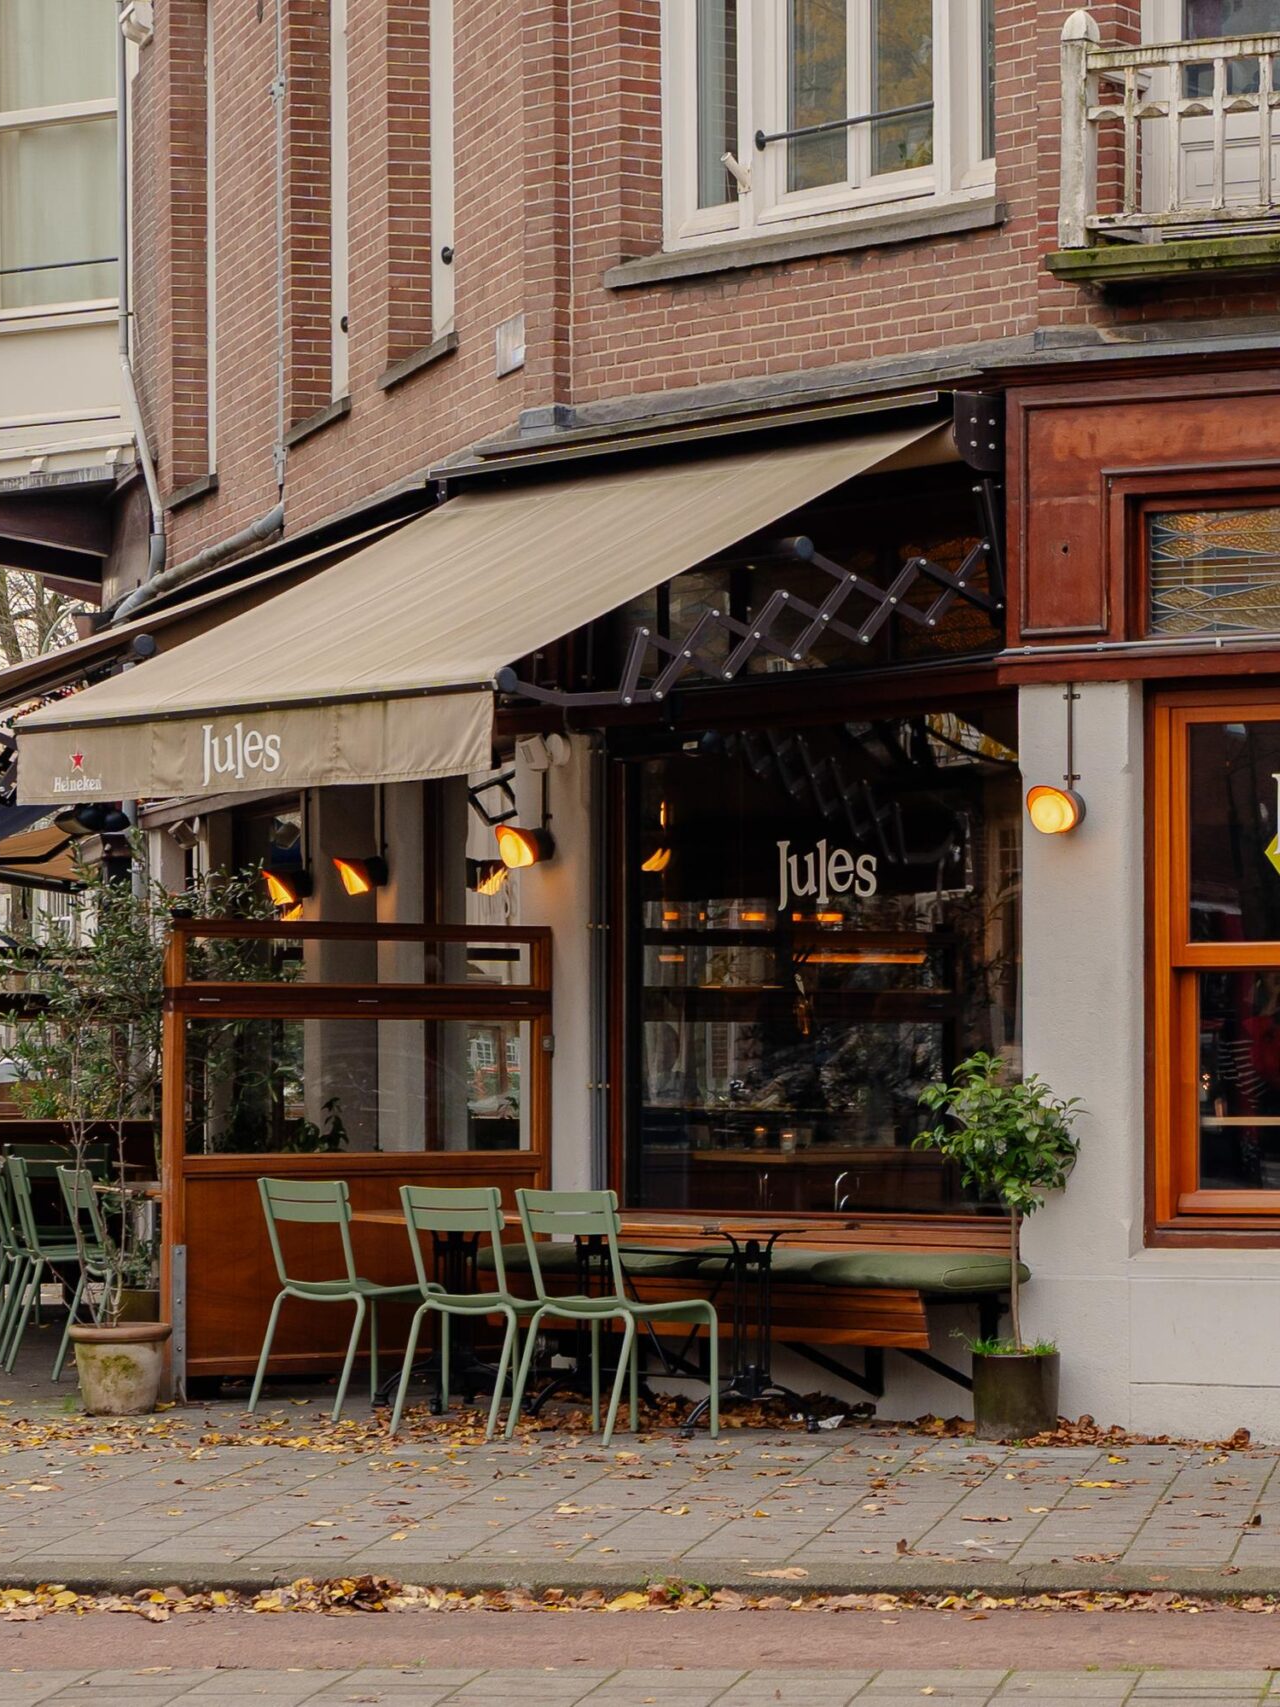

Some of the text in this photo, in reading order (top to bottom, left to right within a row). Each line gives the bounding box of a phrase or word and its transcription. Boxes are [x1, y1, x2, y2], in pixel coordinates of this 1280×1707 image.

[53, 775, 102, 793] Heineken
[202, 721, 282, 787] Jules
[776, 838, 878, 912] Jules
